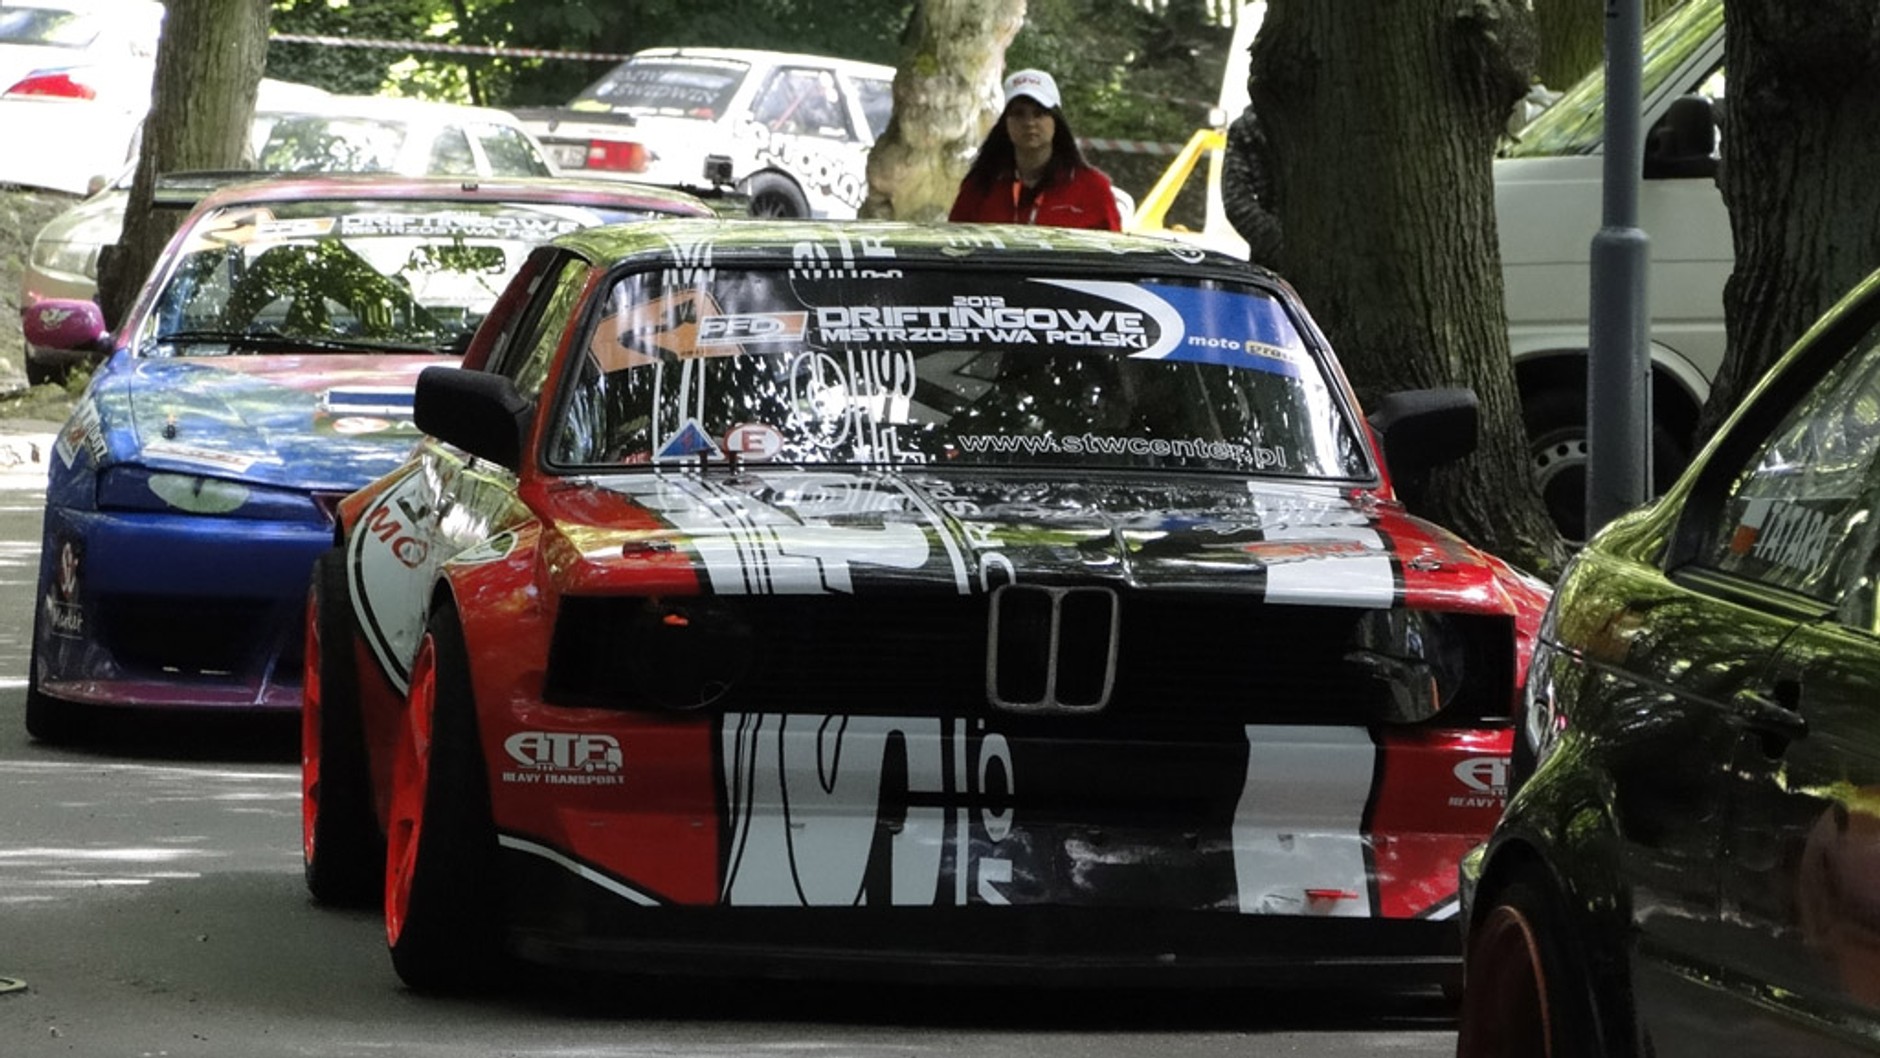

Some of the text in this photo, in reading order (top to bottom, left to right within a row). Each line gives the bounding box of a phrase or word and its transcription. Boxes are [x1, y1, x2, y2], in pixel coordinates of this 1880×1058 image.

[702, 320, 787, 337] PFD
[817, 306, 1145, 334] DRIFTINGOWE
[820, 327, 1149, 348] MISTRZOSTWA POLSKI
[1188, 336, 1241, 350] moto
[741, 430, 767, 453] E
[957, 432, 1287, 468] www.stwcenter.pl
